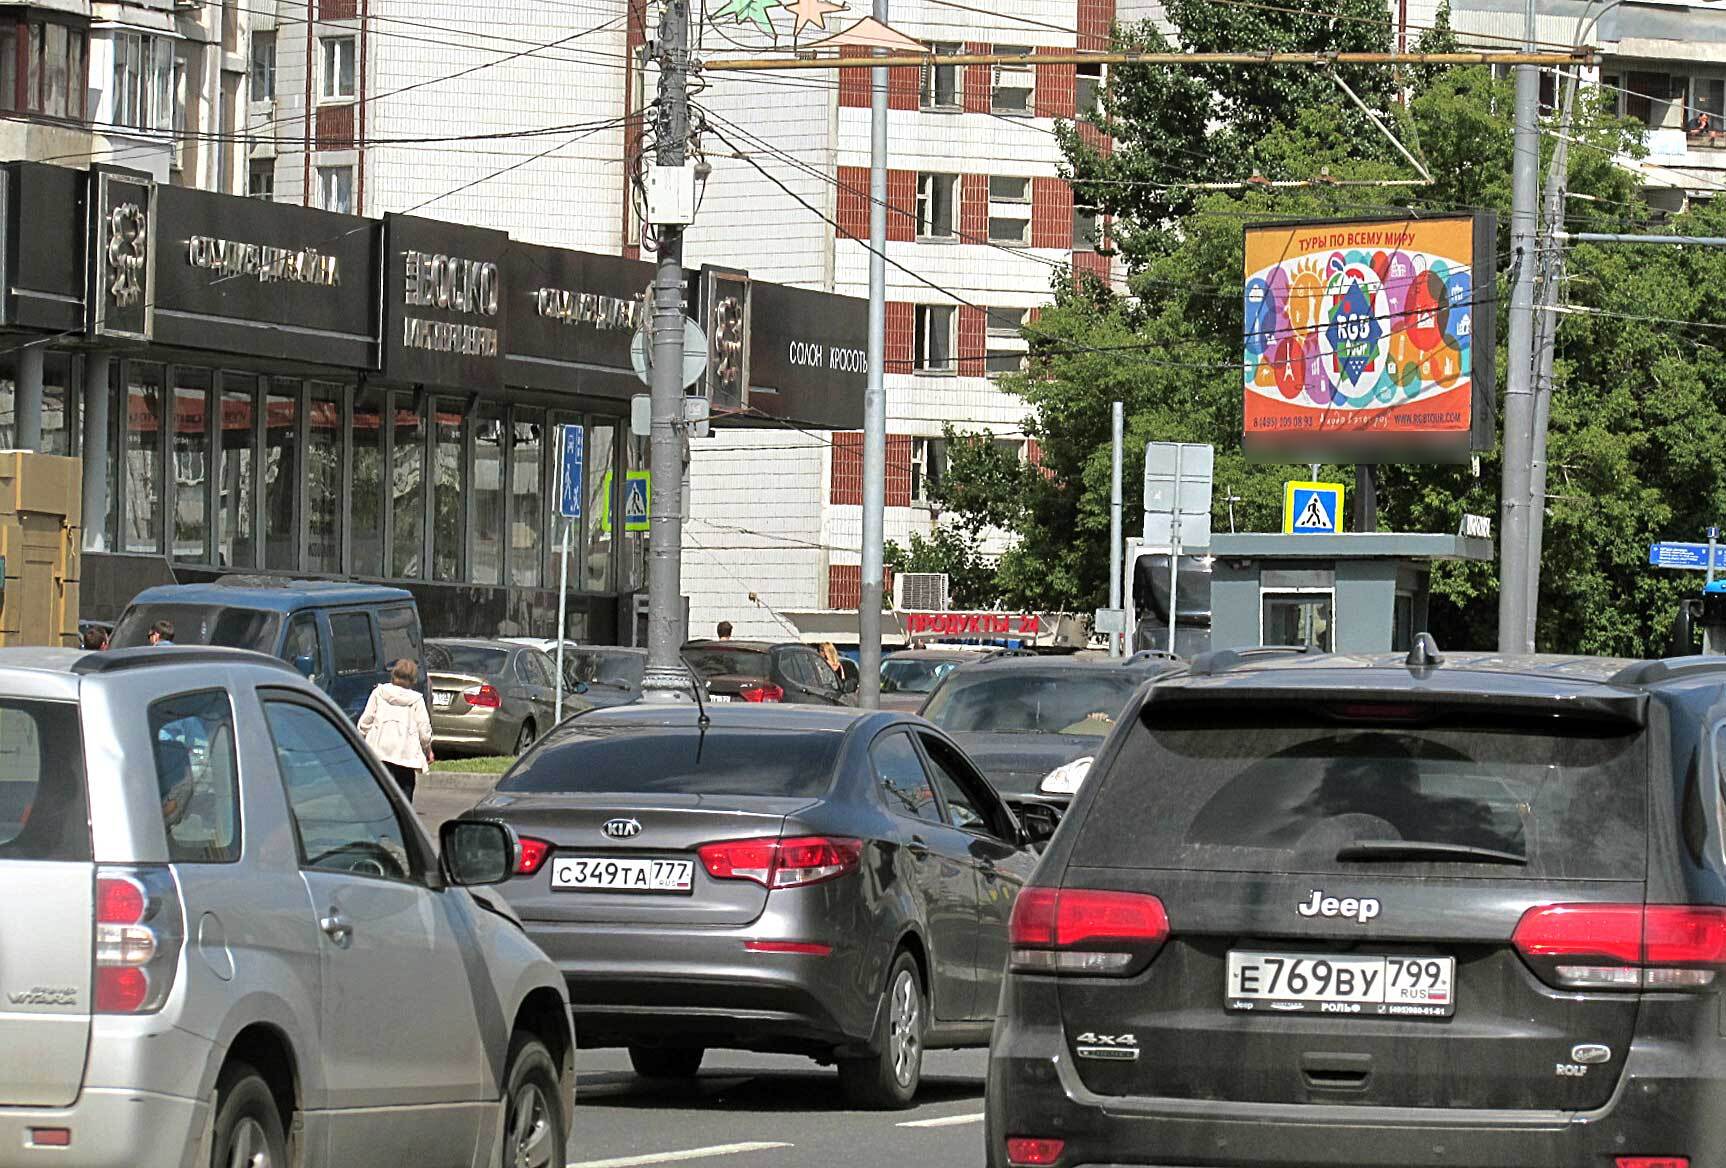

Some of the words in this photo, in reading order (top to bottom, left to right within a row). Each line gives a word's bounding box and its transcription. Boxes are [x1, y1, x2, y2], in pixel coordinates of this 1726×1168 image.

[1299, 235, 1326, 251] ТУРЫ
[1329, 234, 1345, 247] ПО
[1347, 232, 1382, 246] ВСЕМУ
[1384, 231, 1415, 247] МИРУ
[789, 340, 823, 367] САЛОН
[907, 613, 1009, 635] ПРОДУКТЫ
[1018, 614, 1039, 634] 24
[607, 822, 635, 836] KIA
[559, 861, 647, 885] С349ТА
[653, 862, 688, 880] 777
[1298, 890, 1380, 923] Jeep
[1240, 958, 1379, 997] Е769ВУ
[1388, 959, 1441, 988] 799
[1400, 988, 1426, 998] RUS
[1320, 1003, 1361, 1013] РОЛЬФ
[1556, 1063, 1587, 1077] ROLF
